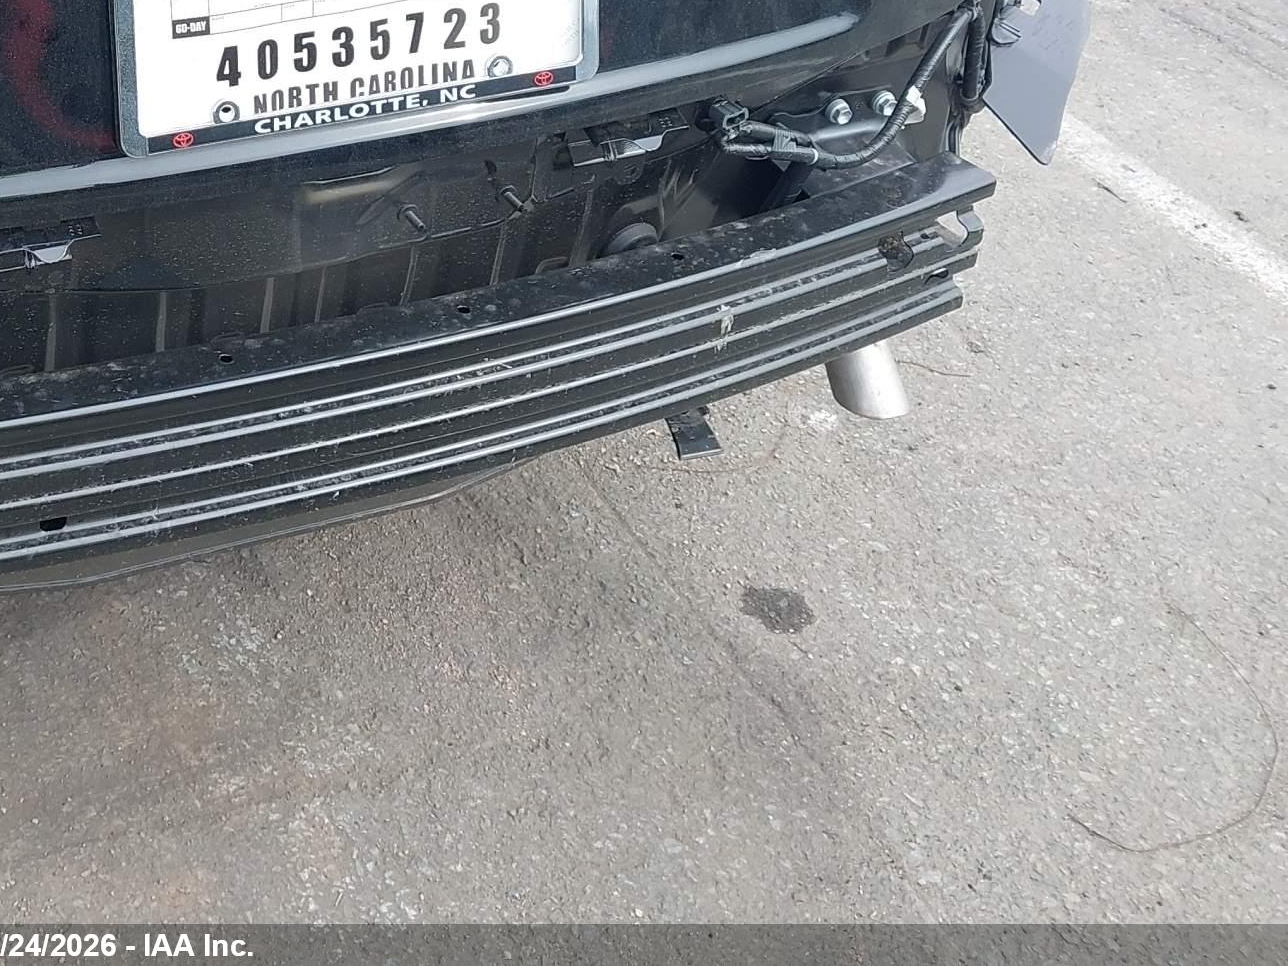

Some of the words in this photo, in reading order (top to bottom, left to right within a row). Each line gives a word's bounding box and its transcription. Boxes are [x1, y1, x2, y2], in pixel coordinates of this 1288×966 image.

[175, 20, 207, 34] 60-DAY
[253, 80, 339, 115] NORTH
[349, 58, 476, 99] CAROLINA
[253, 93, 429, 134] CHARLOTTE,
[439, 83, 477, 103] NC
